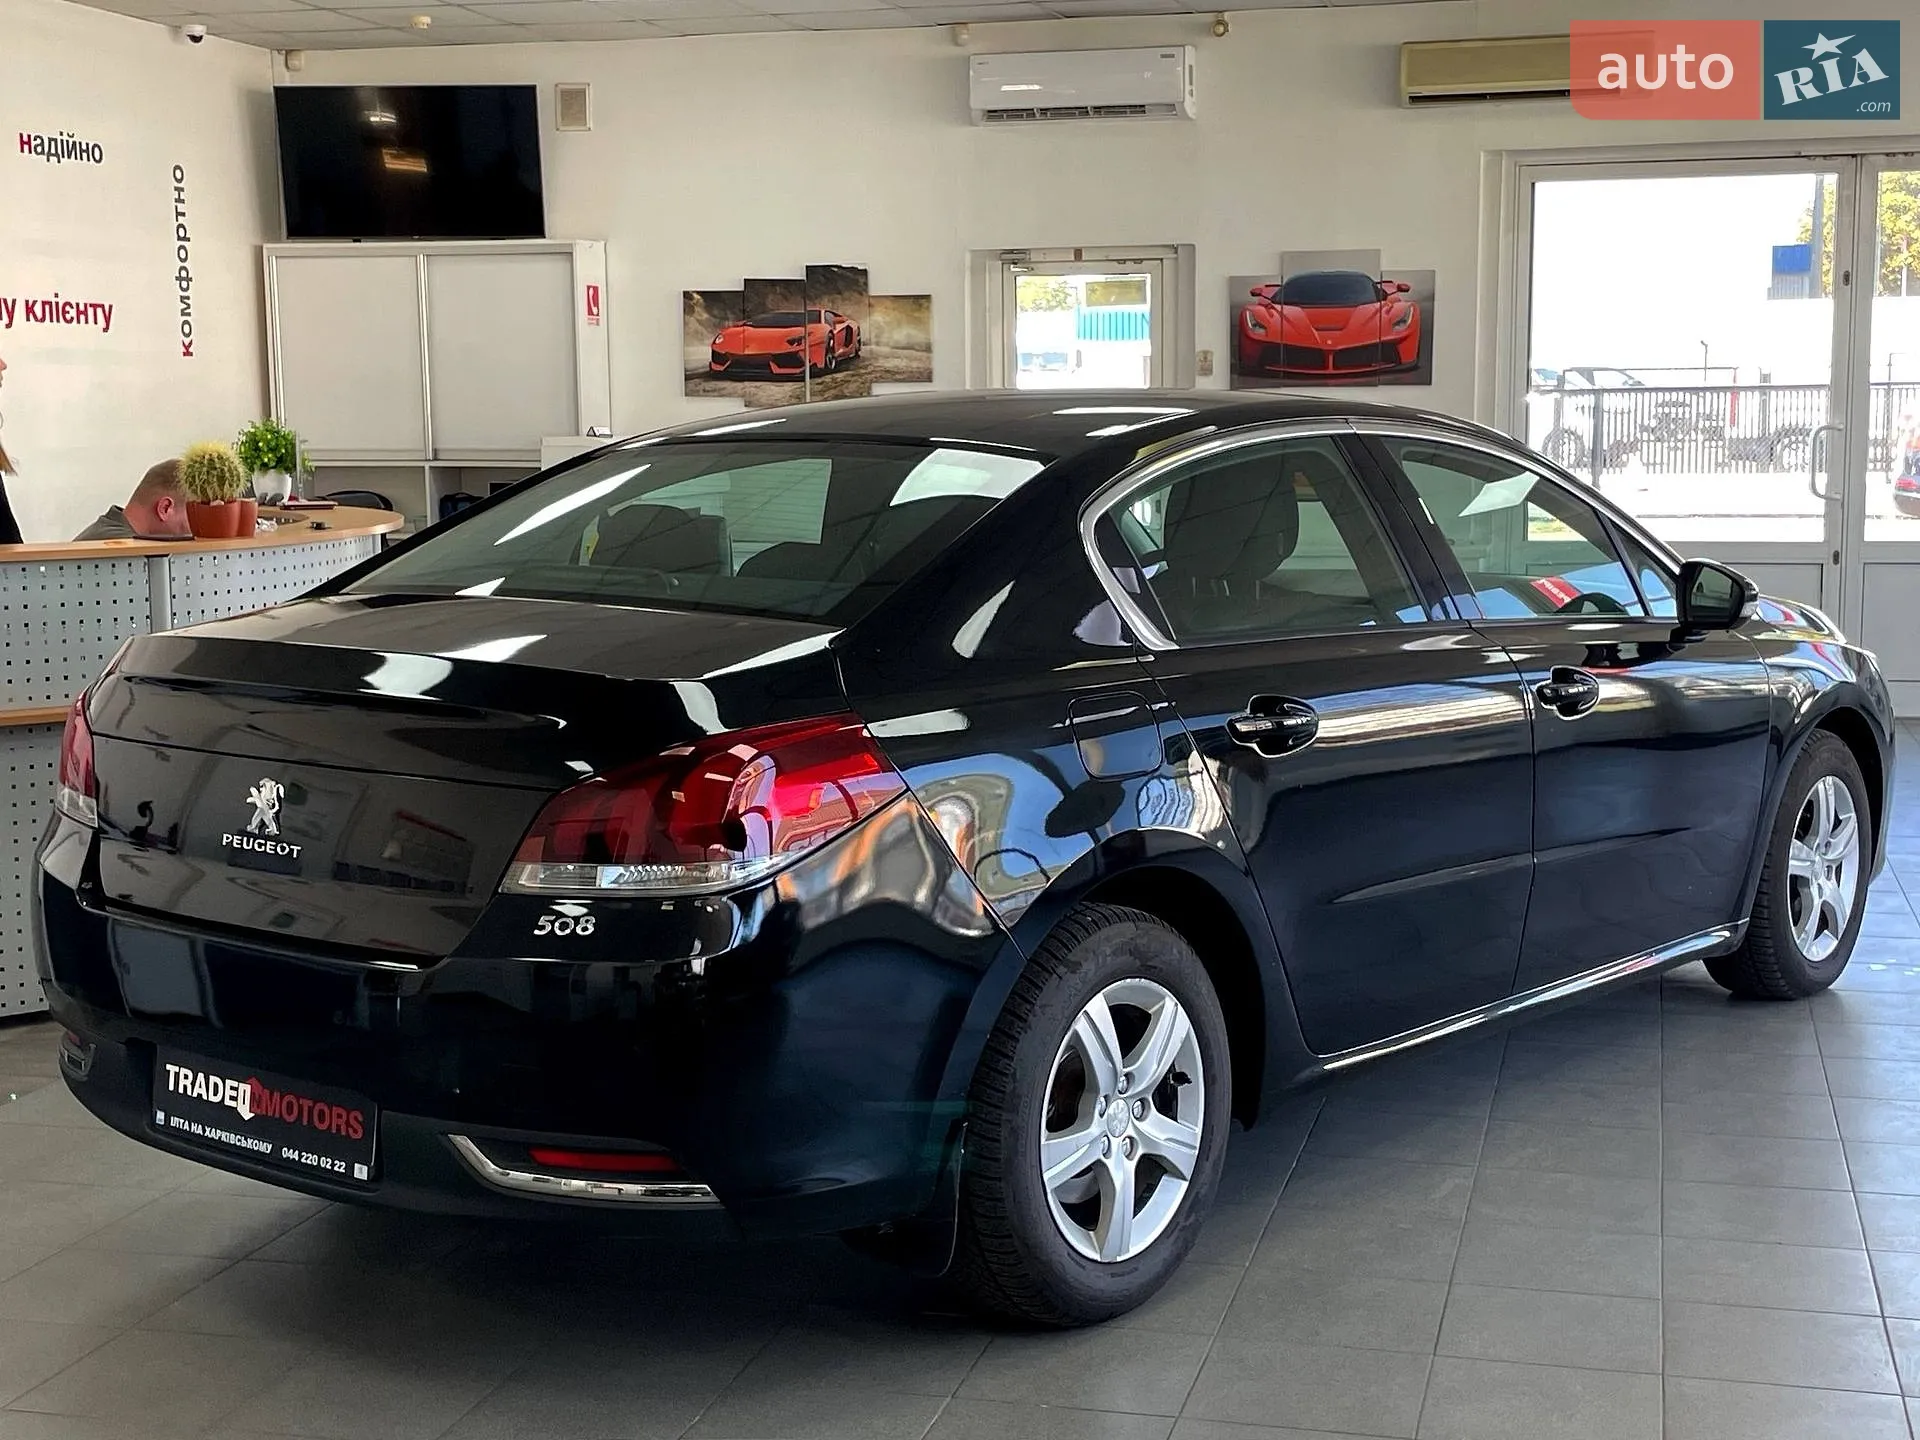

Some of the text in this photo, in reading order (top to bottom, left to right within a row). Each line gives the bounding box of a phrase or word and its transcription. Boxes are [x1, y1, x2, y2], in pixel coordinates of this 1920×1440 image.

[18, 130, 104, 164] надійно
[172, 164, 194, 357] комфортно
[0, 292, 114, 333] у клієнту
[222, 833, 302, 859] PEUGEOT
[533, 915, 596, 936] 508
[281, 1147, 299, 1161] 044
[300, 1151, 318, 1166] 220
[320, 1156, 332, 1170] 02
[333, 1160, 346, 1173] 22
